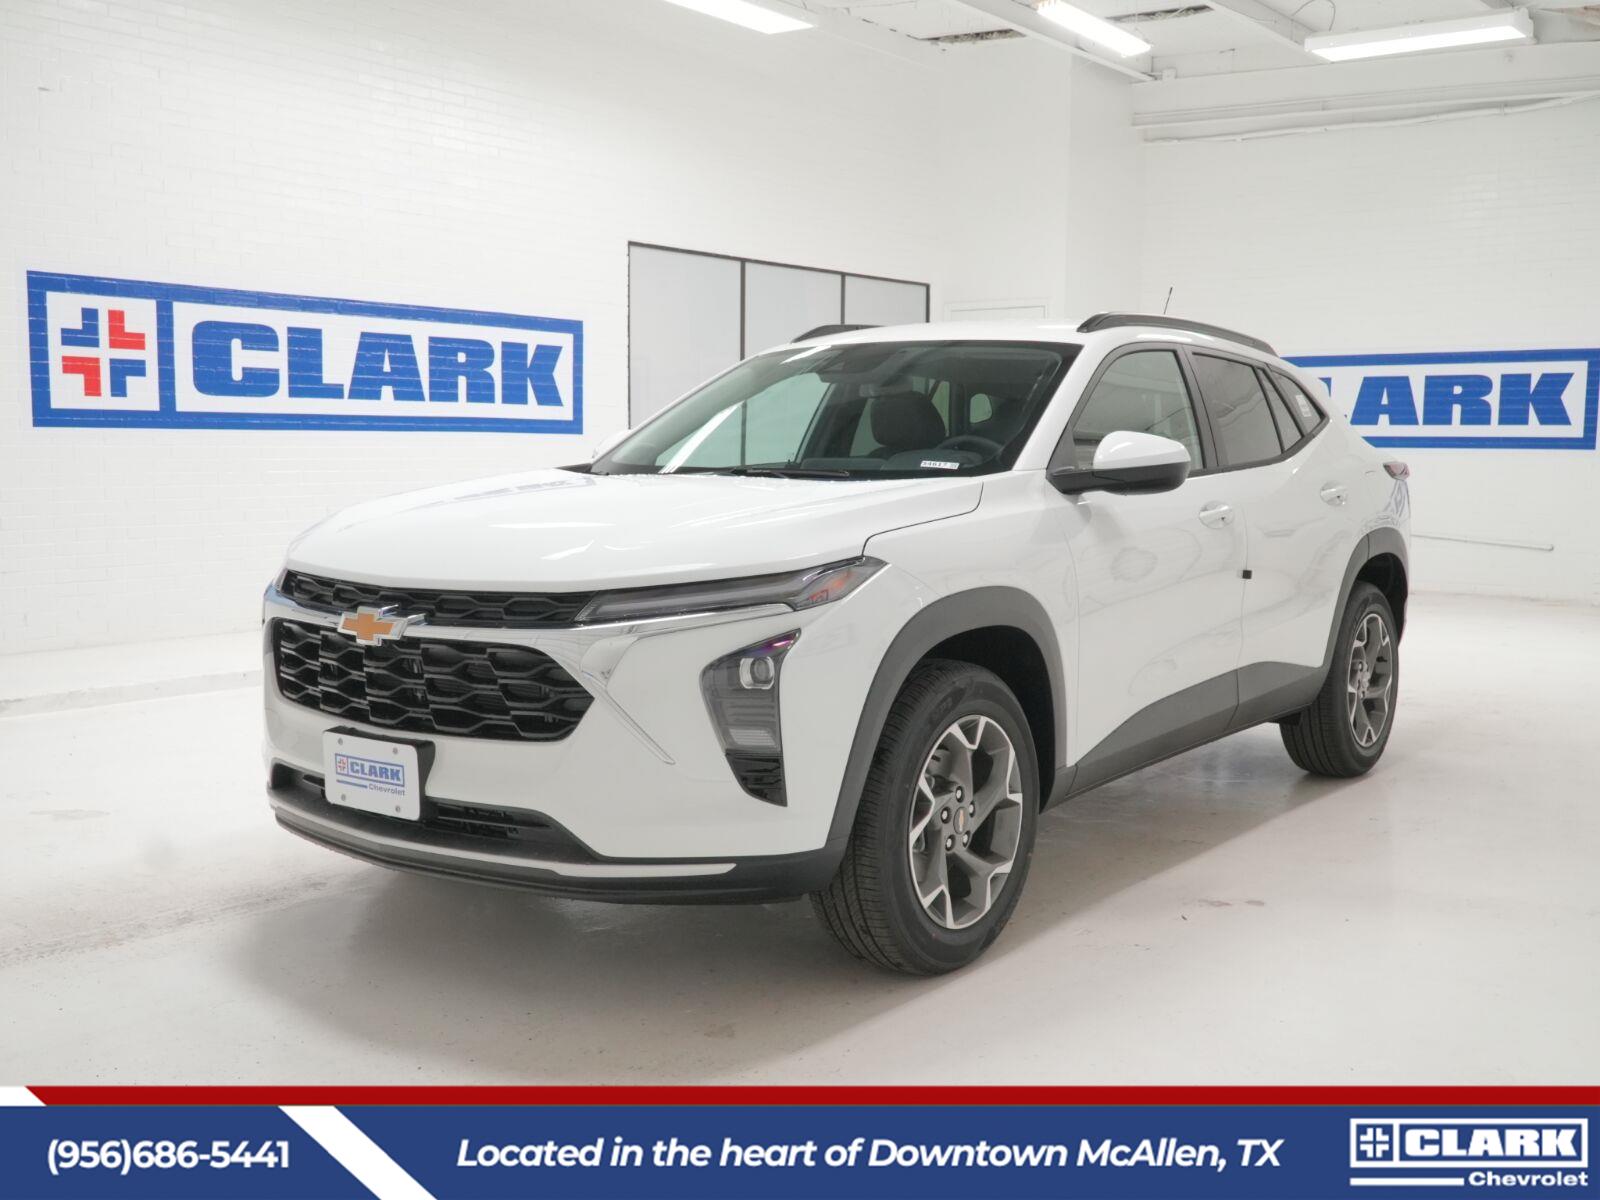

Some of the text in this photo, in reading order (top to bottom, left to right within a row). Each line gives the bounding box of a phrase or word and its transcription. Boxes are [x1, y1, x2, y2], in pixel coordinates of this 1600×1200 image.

[192, 320, 564, 407] CLARK
[1319, 372, 1575, 426] ARK
[350, 761, 401, 781] CLARK
[368, 783, 405, 796] Chevrolet
